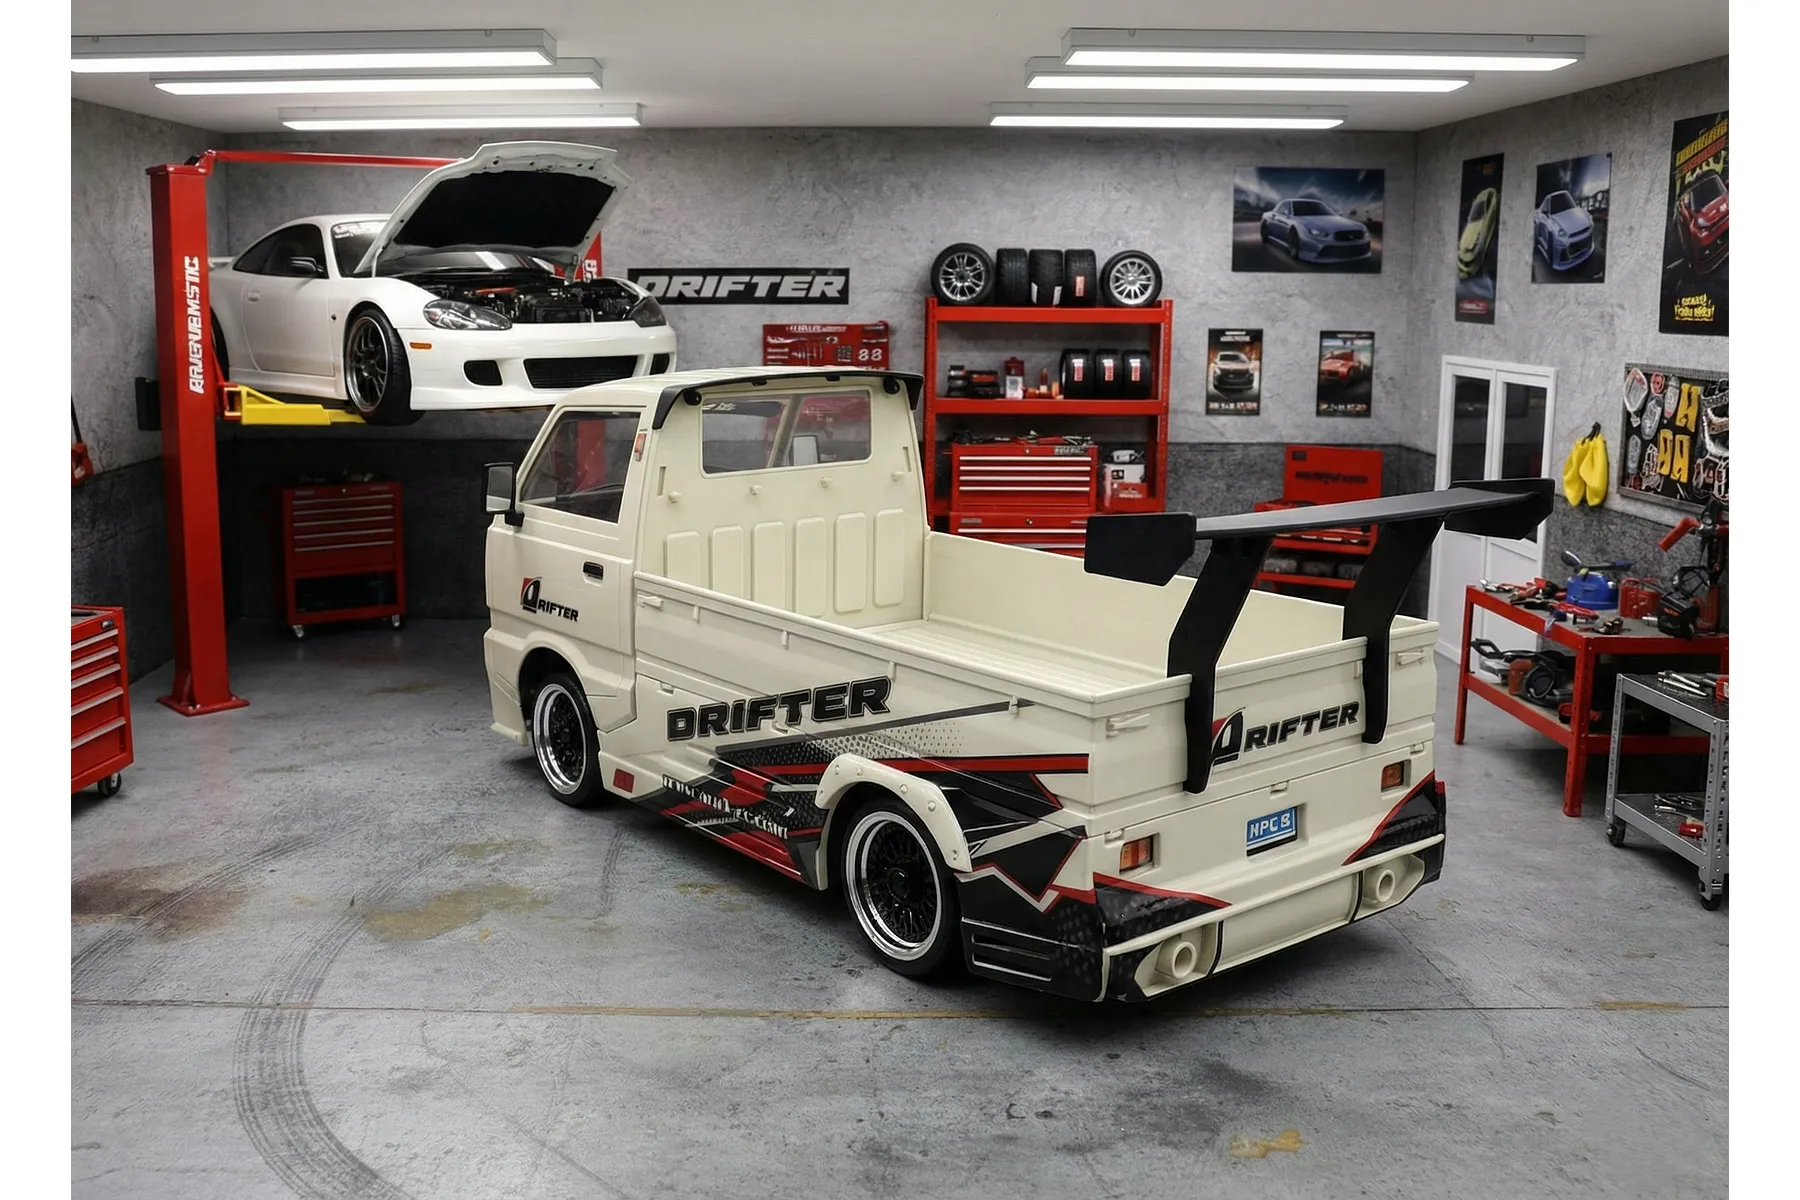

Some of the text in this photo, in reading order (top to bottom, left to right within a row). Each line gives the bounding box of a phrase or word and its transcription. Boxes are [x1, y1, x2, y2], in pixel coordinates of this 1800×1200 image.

[635, 275, 847, 298] DRIFTER
[520, 577, 578, 622] DRIFTER
[667, 675, 892, 742] DRIFTER
[1211, 701, 1360, 767] DRIFTER
